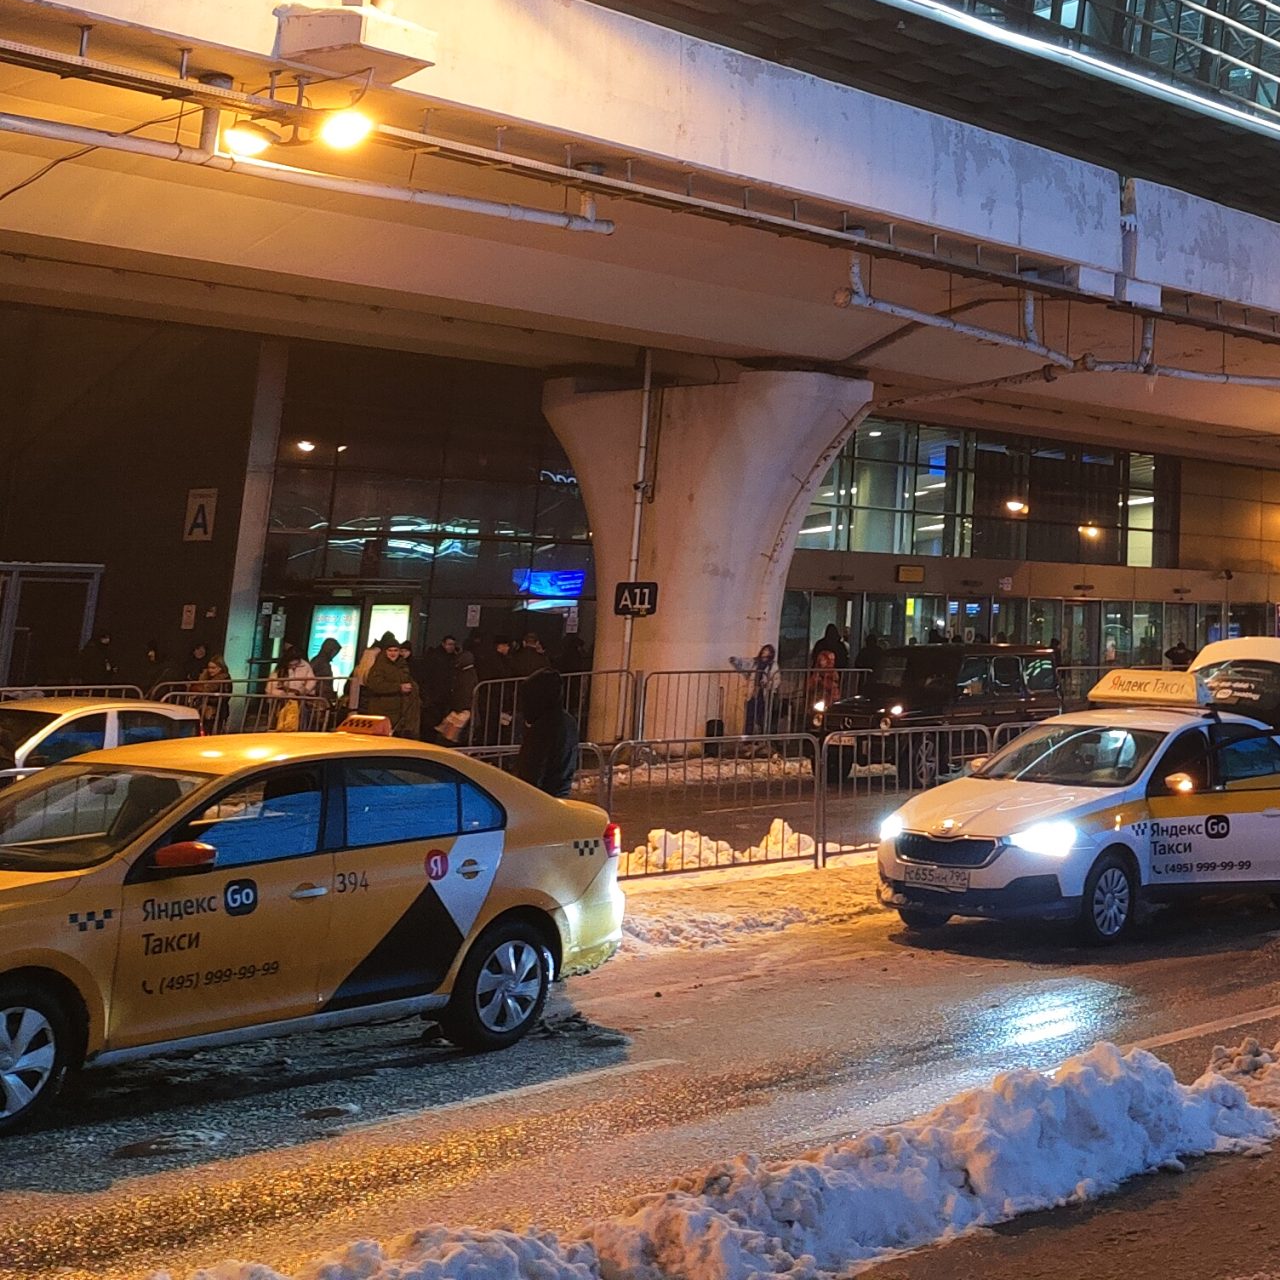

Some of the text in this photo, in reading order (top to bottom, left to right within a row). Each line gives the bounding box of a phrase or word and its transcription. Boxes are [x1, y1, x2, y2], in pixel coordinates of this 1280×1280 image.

[187, 503, 209, 536] A
[618, 588, 652, 609] A11
[1108, 675, 1185, 695] Яндекс Такси
[1150, 819, 1228, 838] Яндекс Go
[1150, 840, 1193, 856] Такси
[430, 855, 442, 876] Я
[1165, 860, 1252, 874] (495) 999-99-99
[336, 871, 370, 893] 394
[141, 884, 254, 922] Яндекс Go
[141, 931, 201, 956] Такси
[158, 960, 280, 995] (495) 999-99-99
